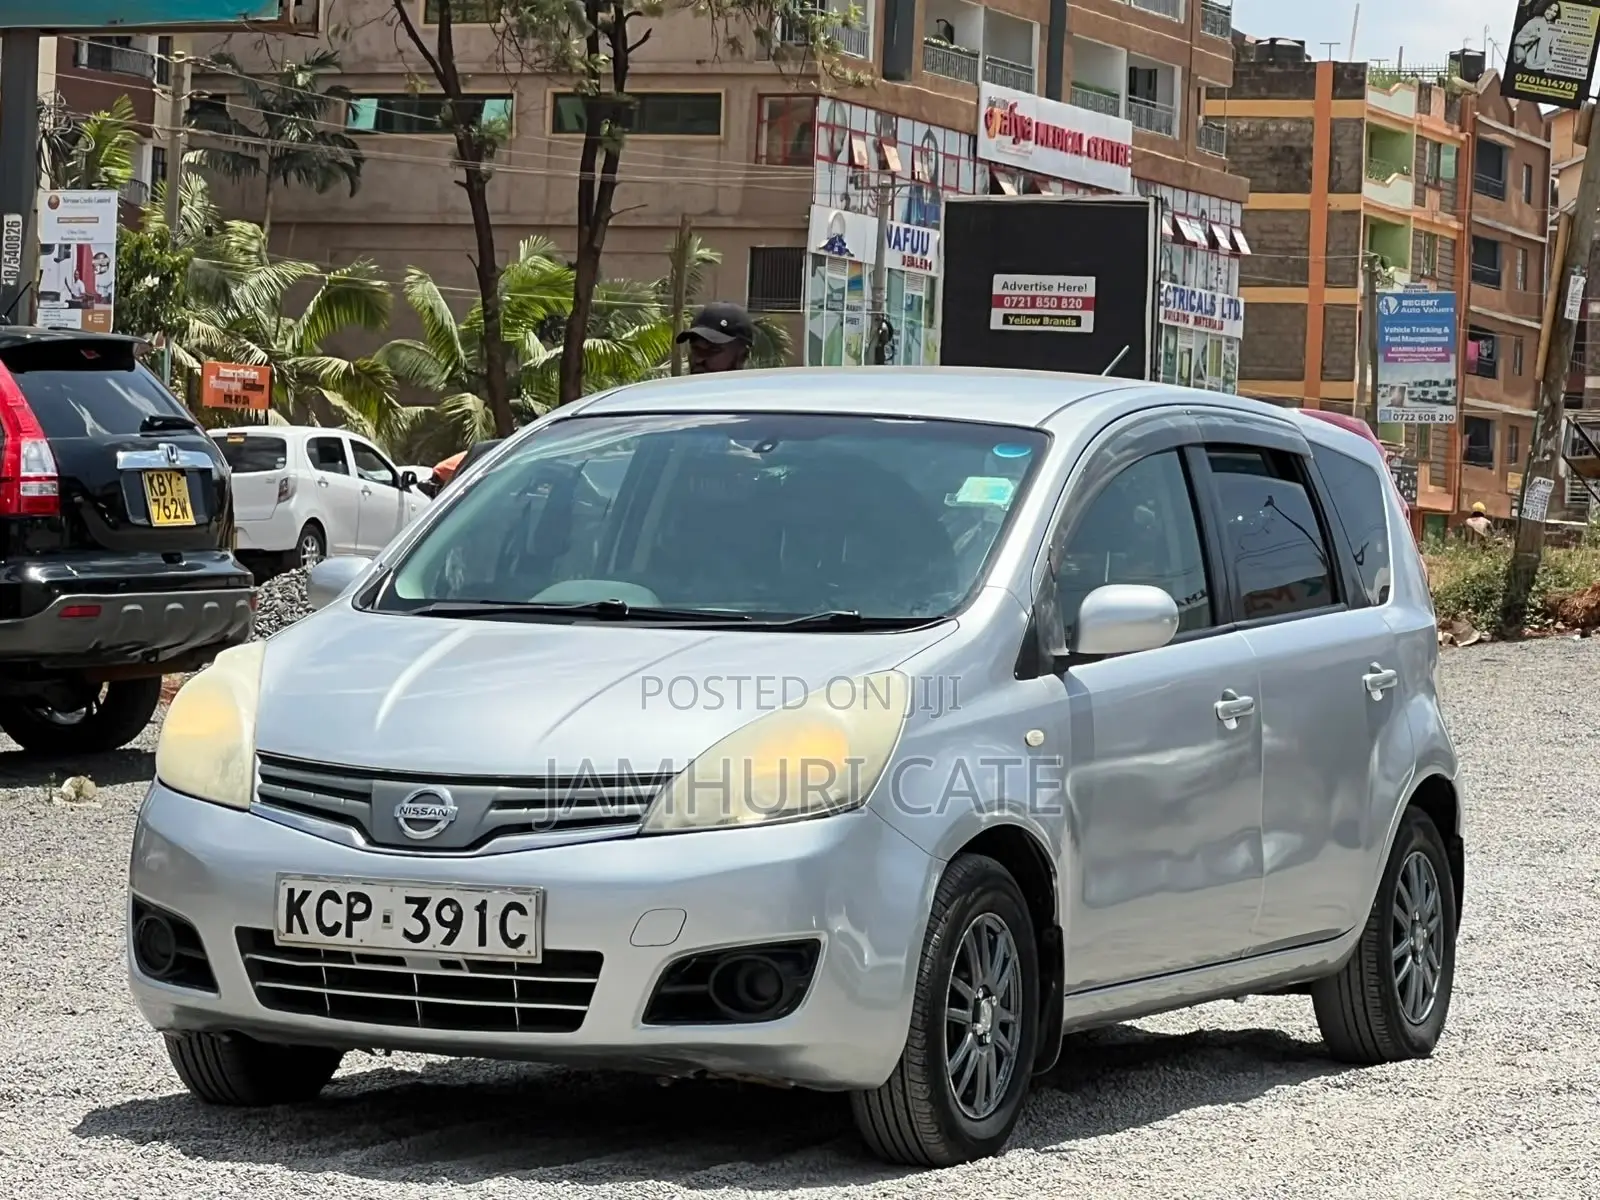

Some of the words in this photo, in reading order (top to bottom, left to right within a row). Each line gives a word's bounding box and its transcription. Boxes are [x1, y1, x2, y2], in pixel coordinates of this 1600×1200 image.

[1034, 121, 1086, 157] MEDICAL
[1087, 135, 1132, 168] CENTRE
[1001, 281, 1054, 292] Advertise
[1057, 282, 1088, 293] Here!
[1003, 296, 1031, 308] 0721
[1036, 297, 1058, 308] 850
[1061, 298, 1082, 309] 820
[1221, 297, 1243, 321] LTD.
[1008, 315, 1040, 325] Yellow
[1042, 316, 1076, 326] Brands
[1411, 326, 1443, 334] Tracking
[1393, 413, 1415, 421] 0722
[1439, 413, 1454, 421] 210
[147, 473, 174, 497] KBY
[152, 498, 189, 520] 762W
[399, 806, 449, 817] NISSAN
[285, 887, 373, 939] KCP
[402, 895, 528, 950] 391C
